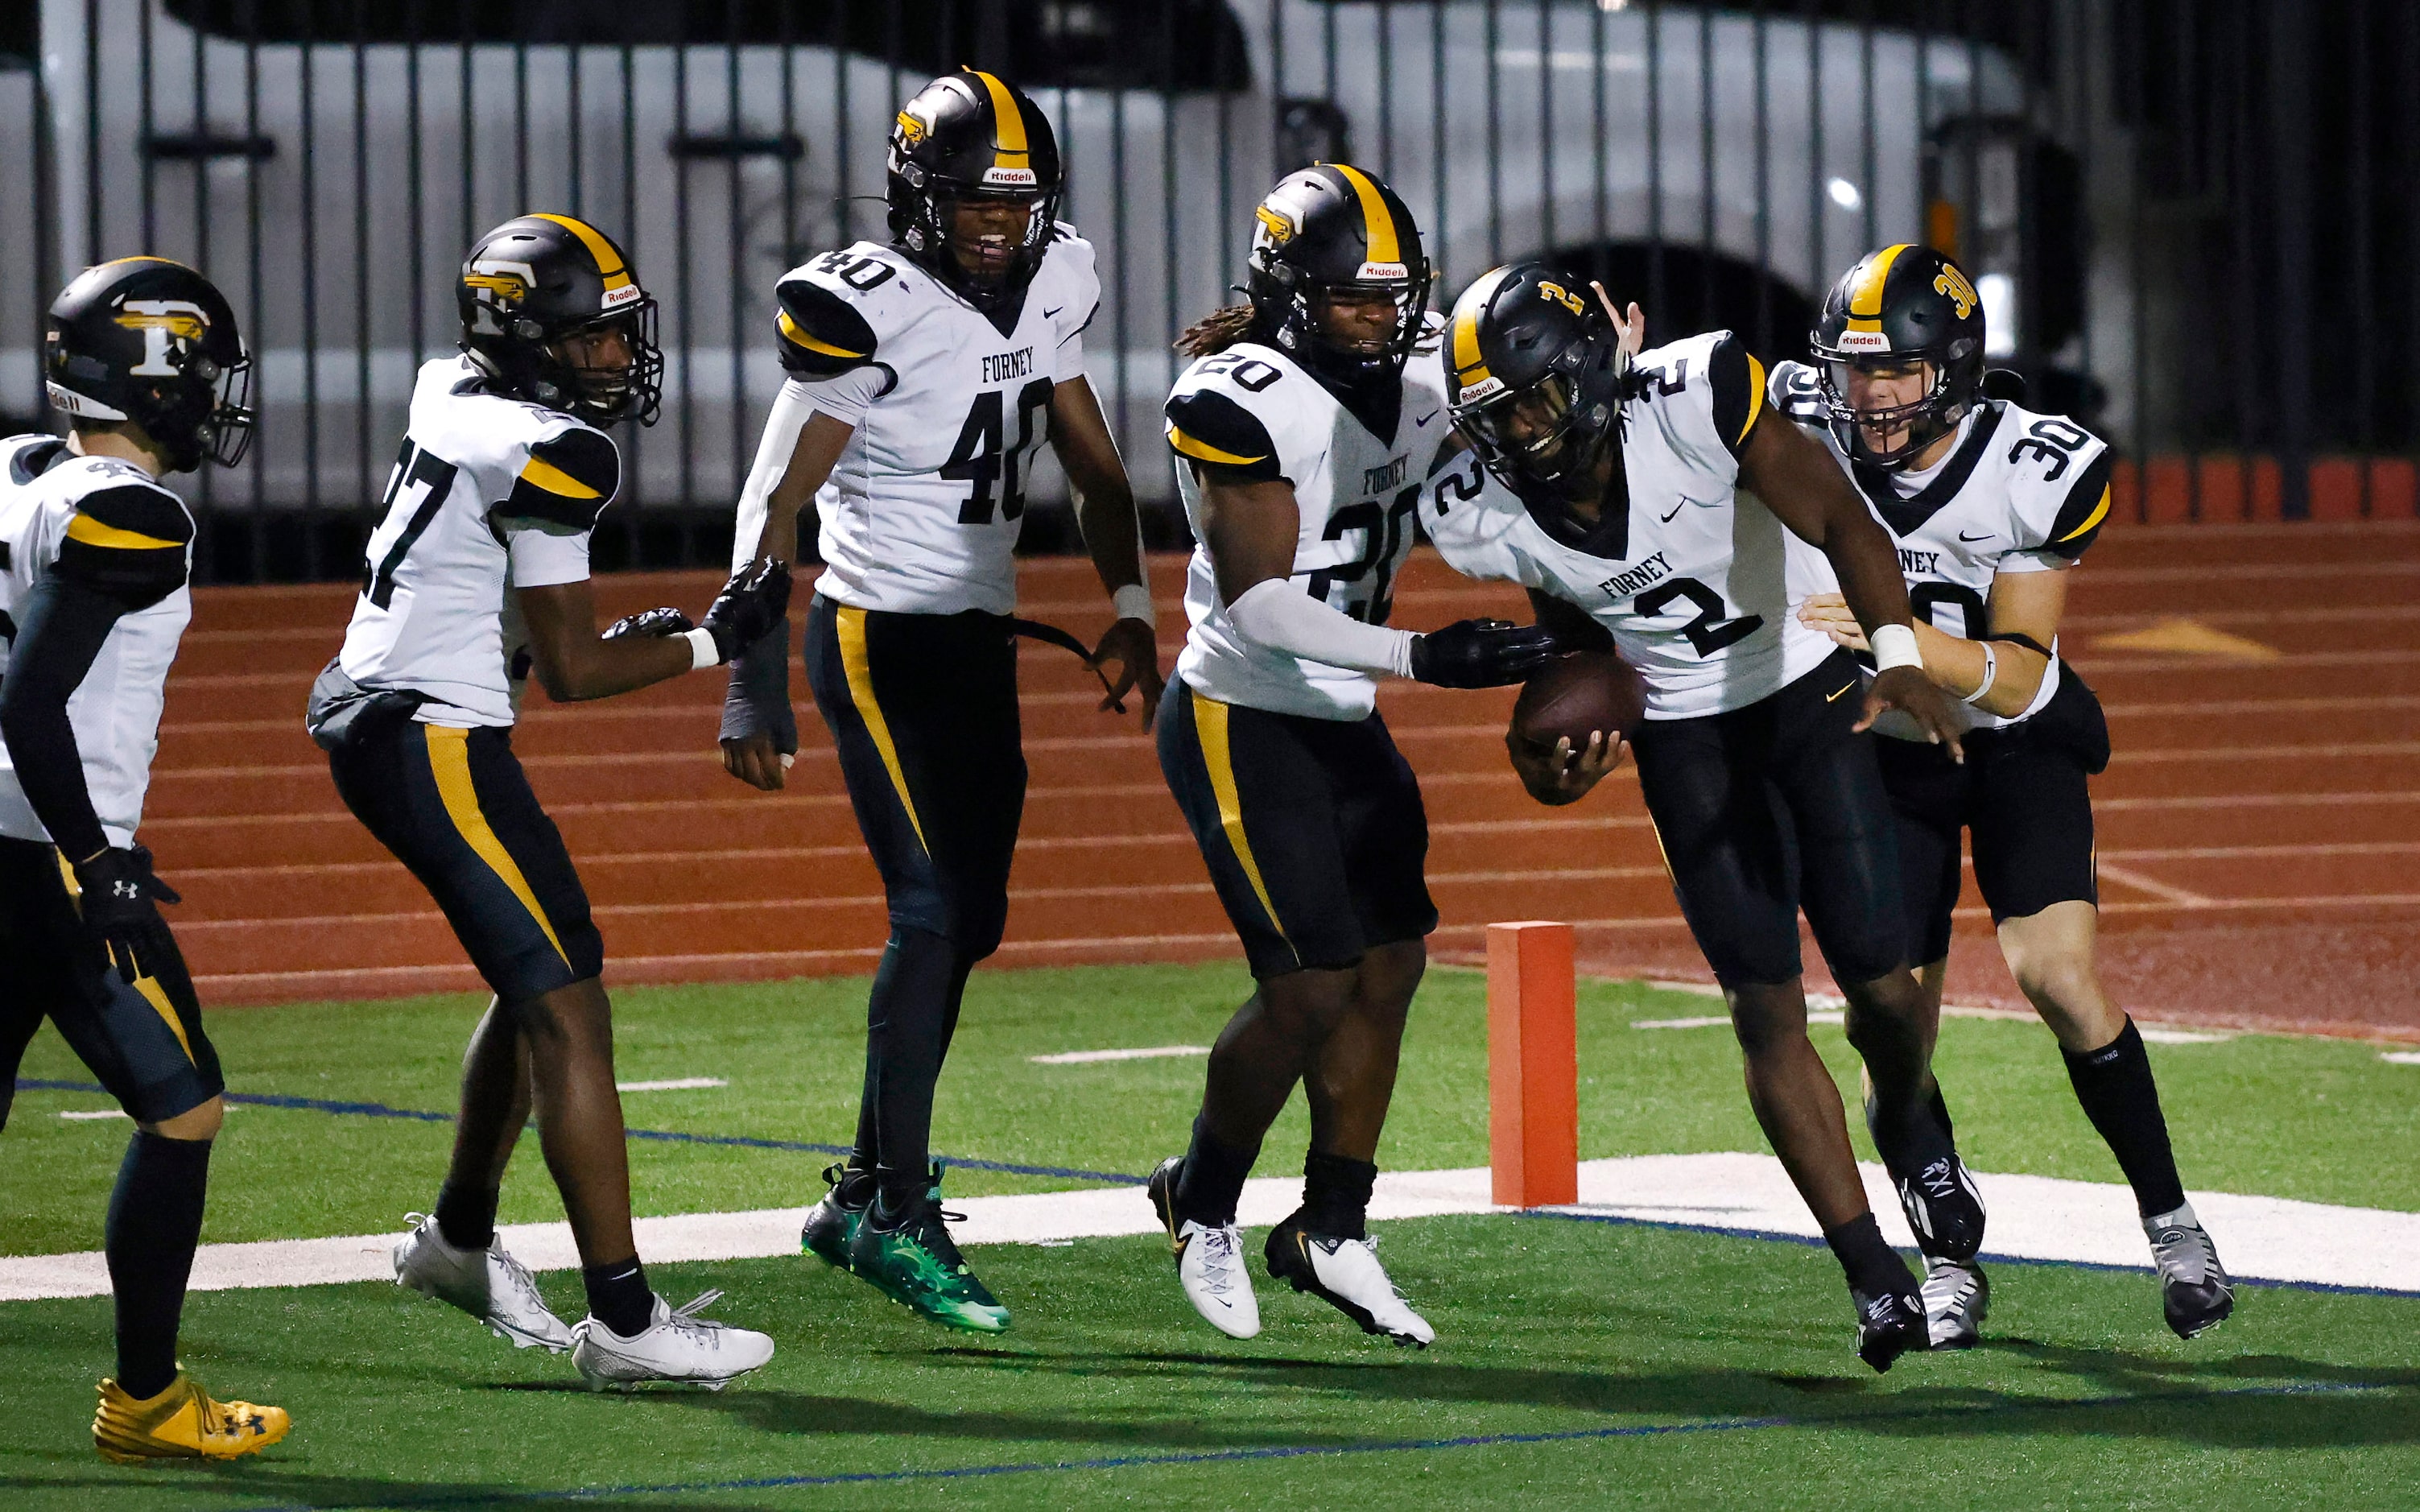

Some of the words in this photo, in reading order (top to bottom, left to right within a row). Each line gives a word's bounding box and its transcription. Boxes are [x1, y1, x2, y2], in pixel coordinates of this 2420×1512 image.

[992, 171, 1031, 182] Riddell
[816, 251, 897, 291] 40
[1366, 266, 1405, 279] Riddell
[608, 286, 638, 304] Riddell
[1538, 281, 1585, 316] 2
[1933, 262, 1977, 320] 30
[1842, 336, 1882, 346] Riddell
[981, 345, 1034, 383] FORNEY
[1193, 353, 1283, 393] 20
[1461, 382, 1495, 401] Riddell
[937, 375, 1055, 524] 40
[2008, 419, 2091, 481] 30
[1435, 459, 1485, 517] 2
[1597, 550, 1674, 599] FORNEY
[1898, 548, 1940, 574] NEY
[1633, 576, 1765, 659] 2
